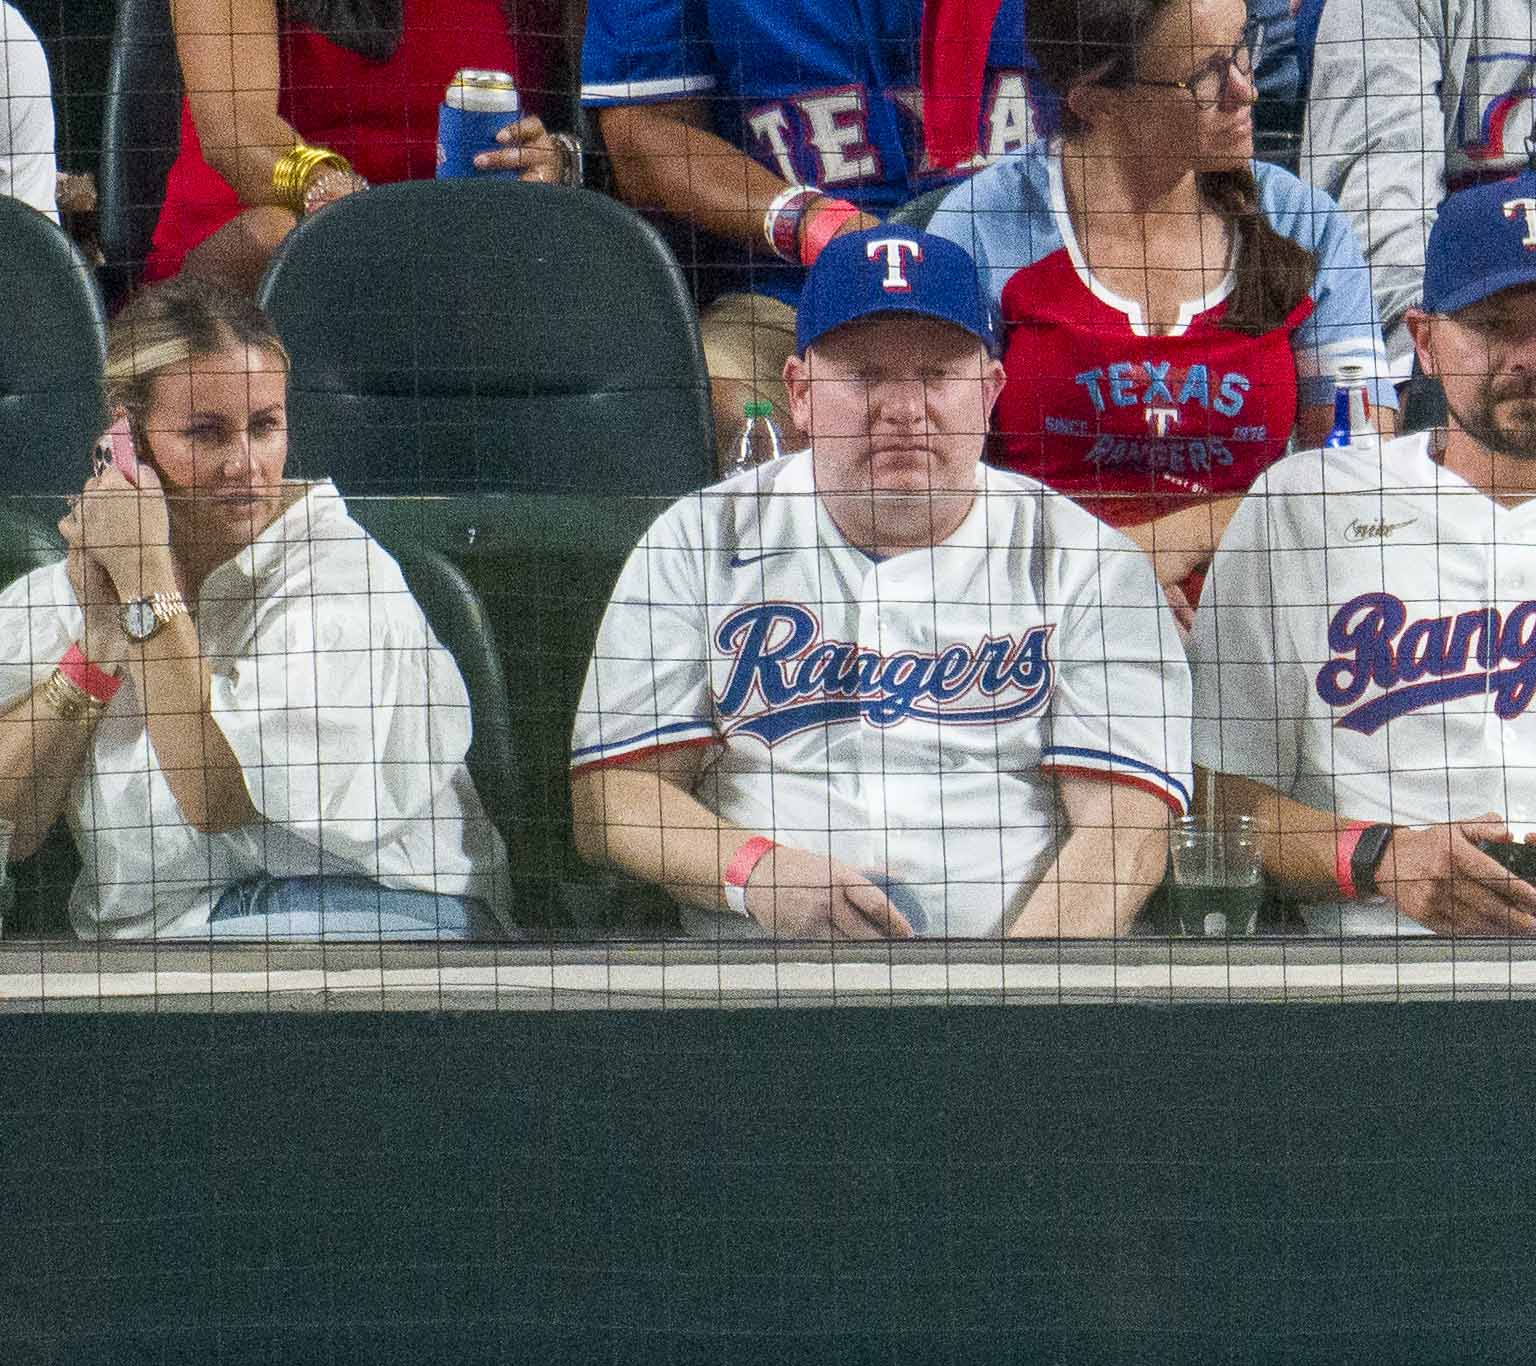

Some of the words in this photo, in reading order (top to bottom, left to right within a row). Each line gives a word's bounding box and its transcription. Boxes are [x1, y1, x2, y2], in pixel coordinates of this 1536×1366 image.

[866, 238, 924, 293] T
[1075, 360, 1250, 418] TEXAS
[1144, 407, 1180, 438] T
[714, 601, 1056, 750] Rangers
